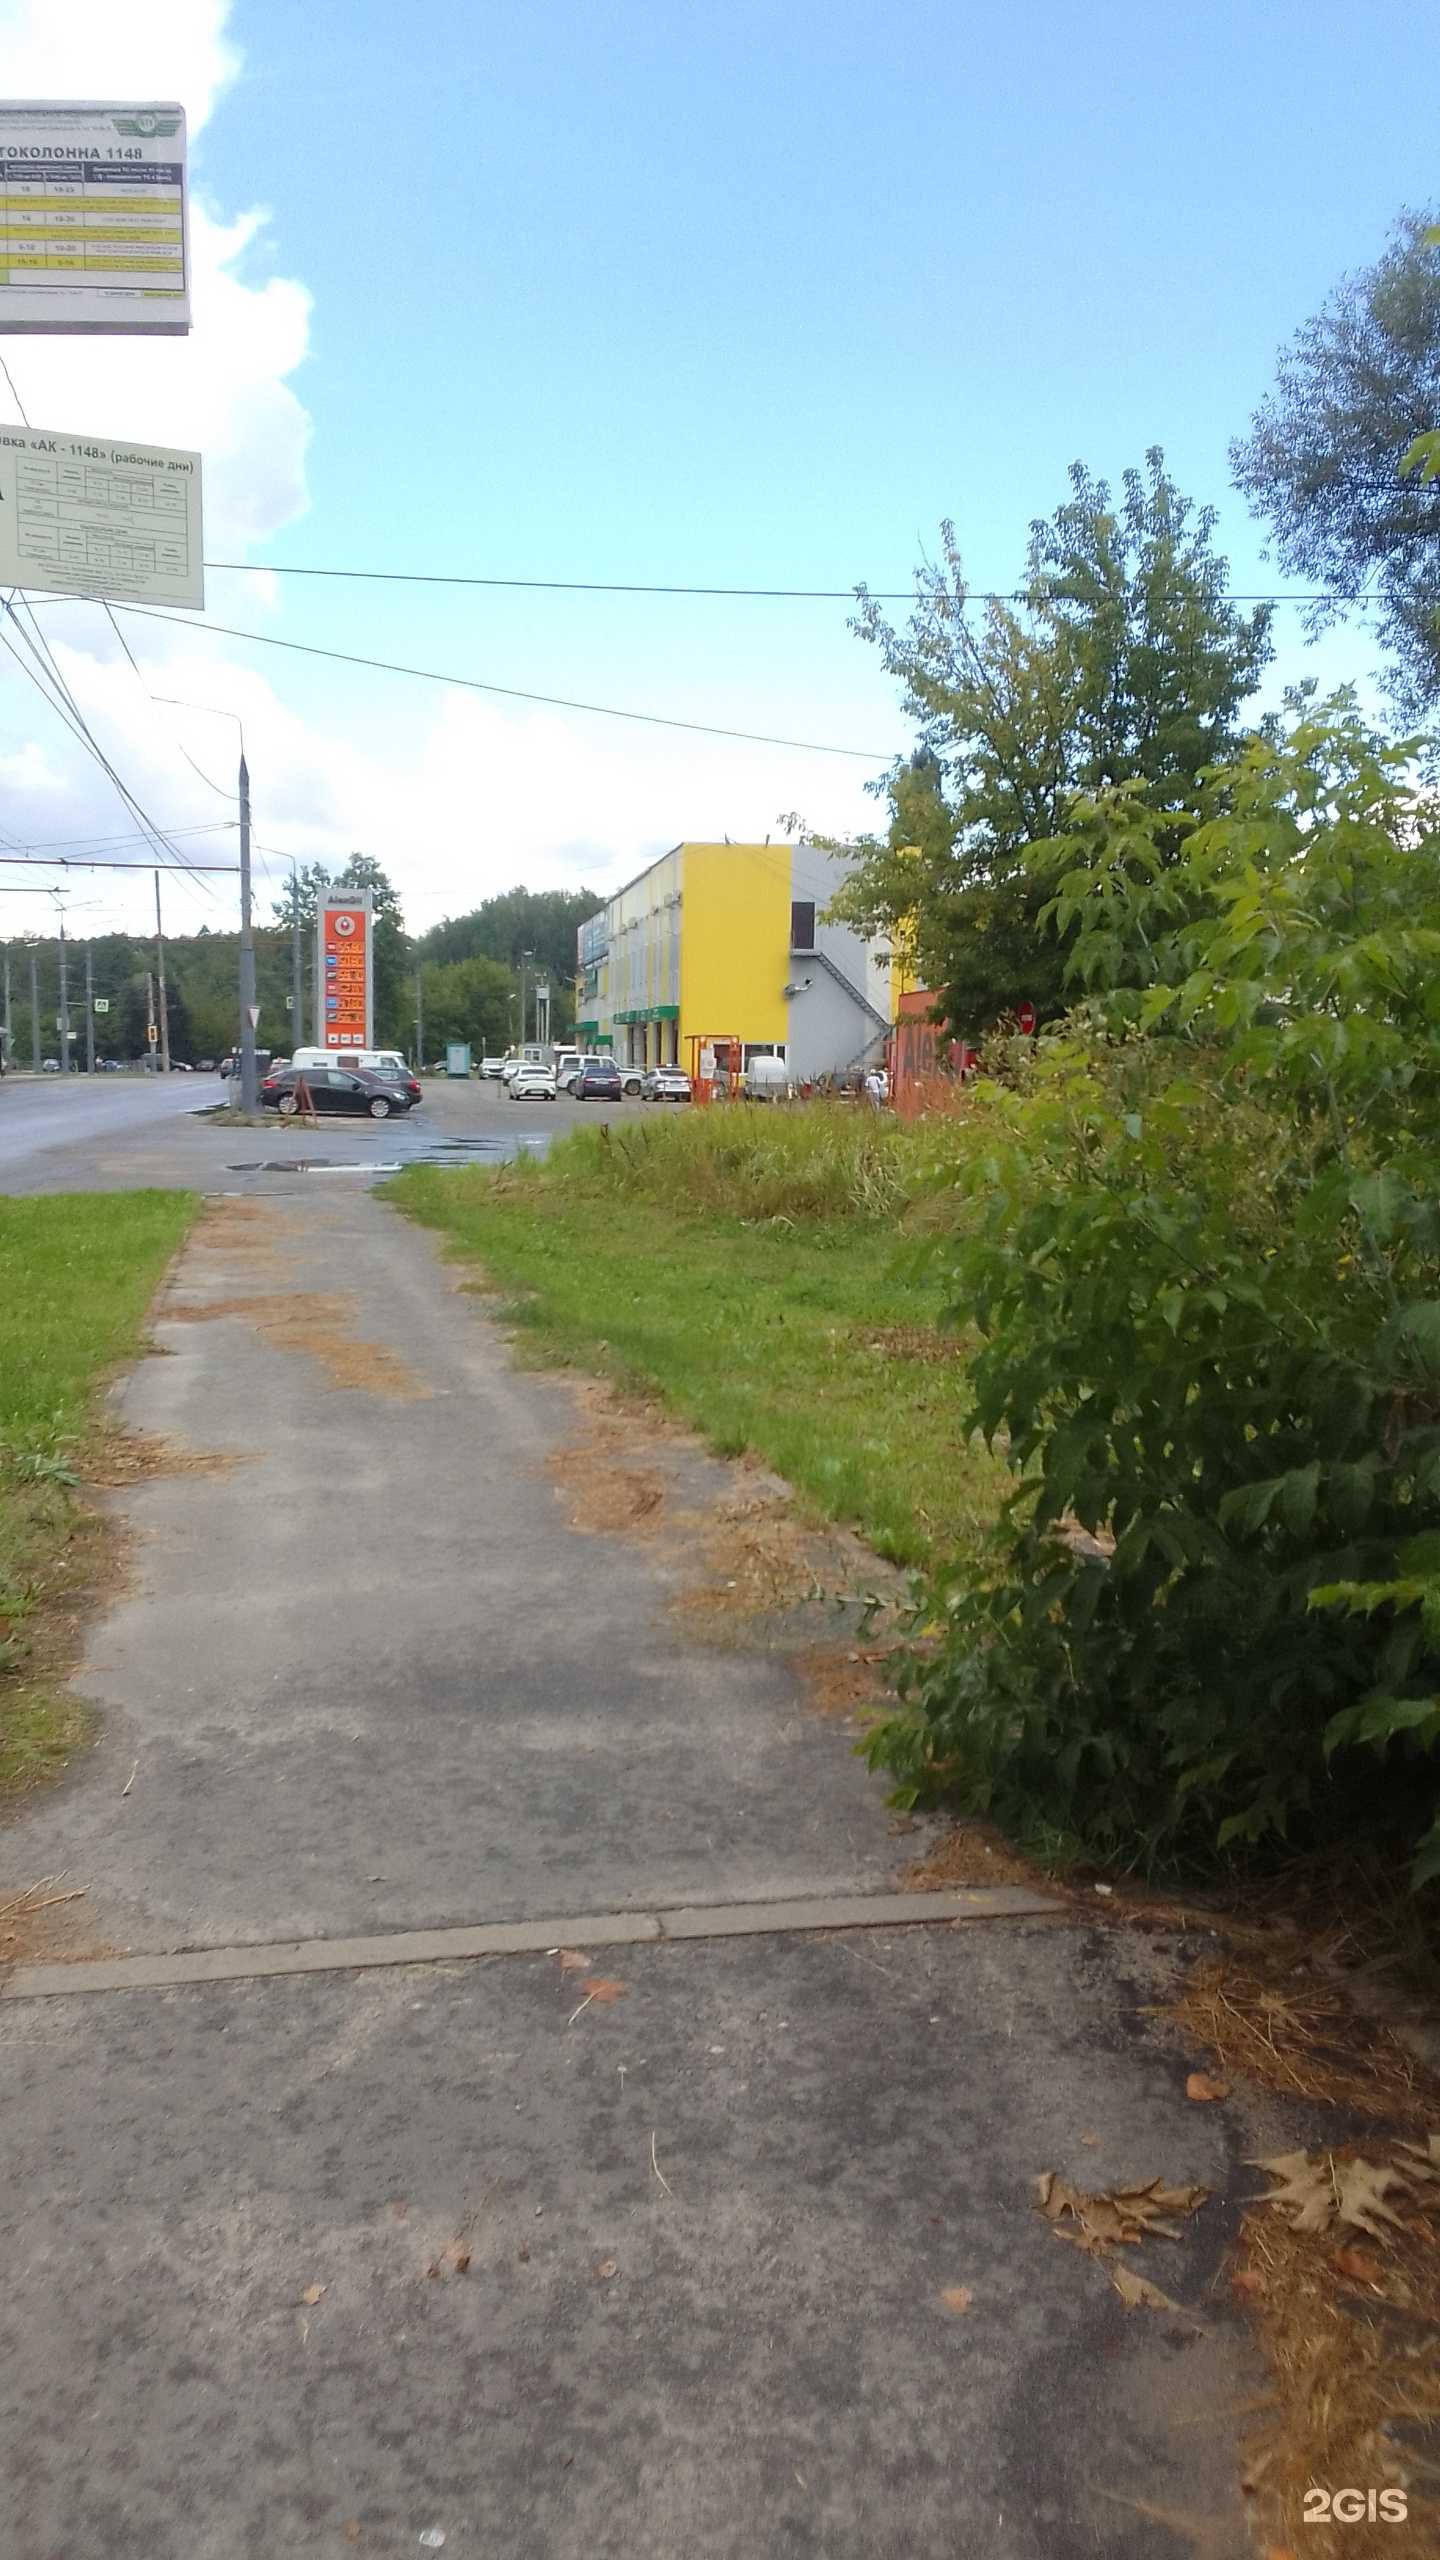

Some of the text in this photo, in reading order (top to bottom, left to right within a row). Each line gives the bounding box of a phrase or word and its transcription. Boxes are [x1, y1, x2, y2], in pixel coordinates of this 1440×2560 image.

[107, 146, 142, 159] 1148
[31, 439, 56, 453] «АК
[70, 444, 106, 459] 1148»
[111, 449, 164, 469] (рабочие
[167, 460, 194, 475] дни)
